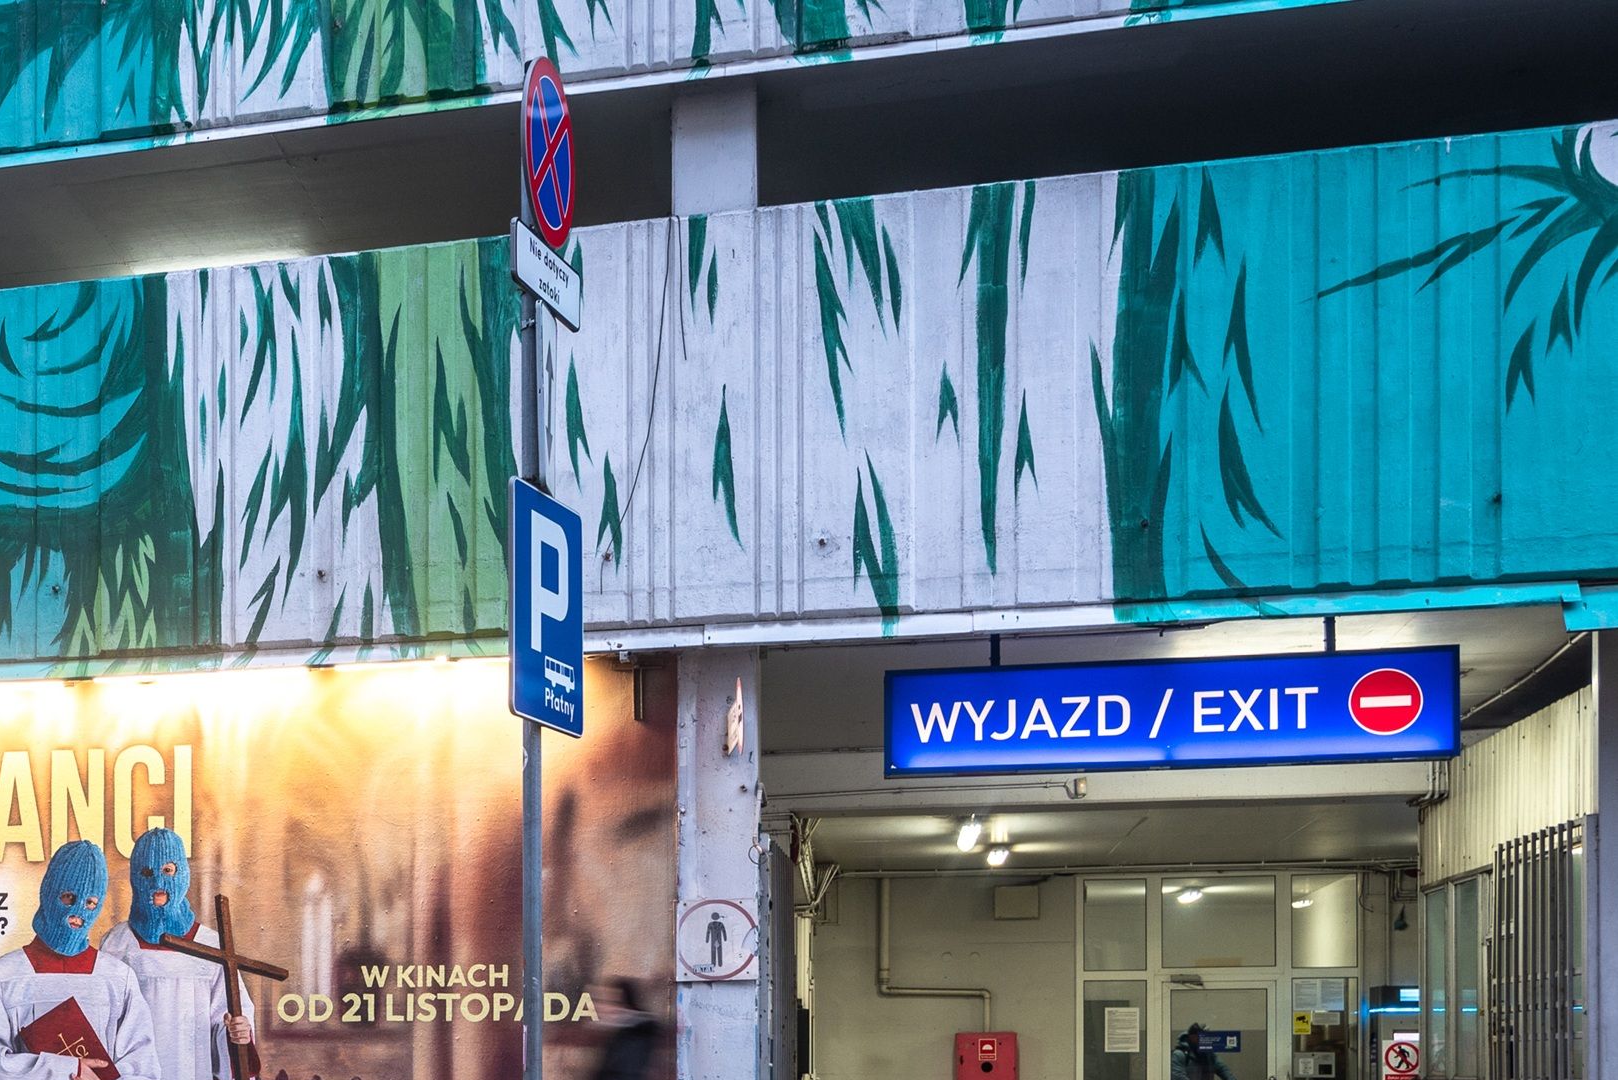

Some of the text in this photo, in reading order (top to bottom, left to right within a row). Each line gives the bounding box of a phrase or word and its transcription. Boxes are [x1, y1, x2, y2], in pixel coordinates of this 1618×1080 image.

[529, 236, 569, 289] Nie dotyczy
[538, 277, 560, 305] zatoki
[531, 508, 569, 653] P
[544, 686, 575, 723] Płatny
[910, 685, 1320, 744] WYJAZD / EXIT
[360, 963, 509, 988] W KINACH
[276, 991, 599, 1023] OD 21 LISTOPDA
